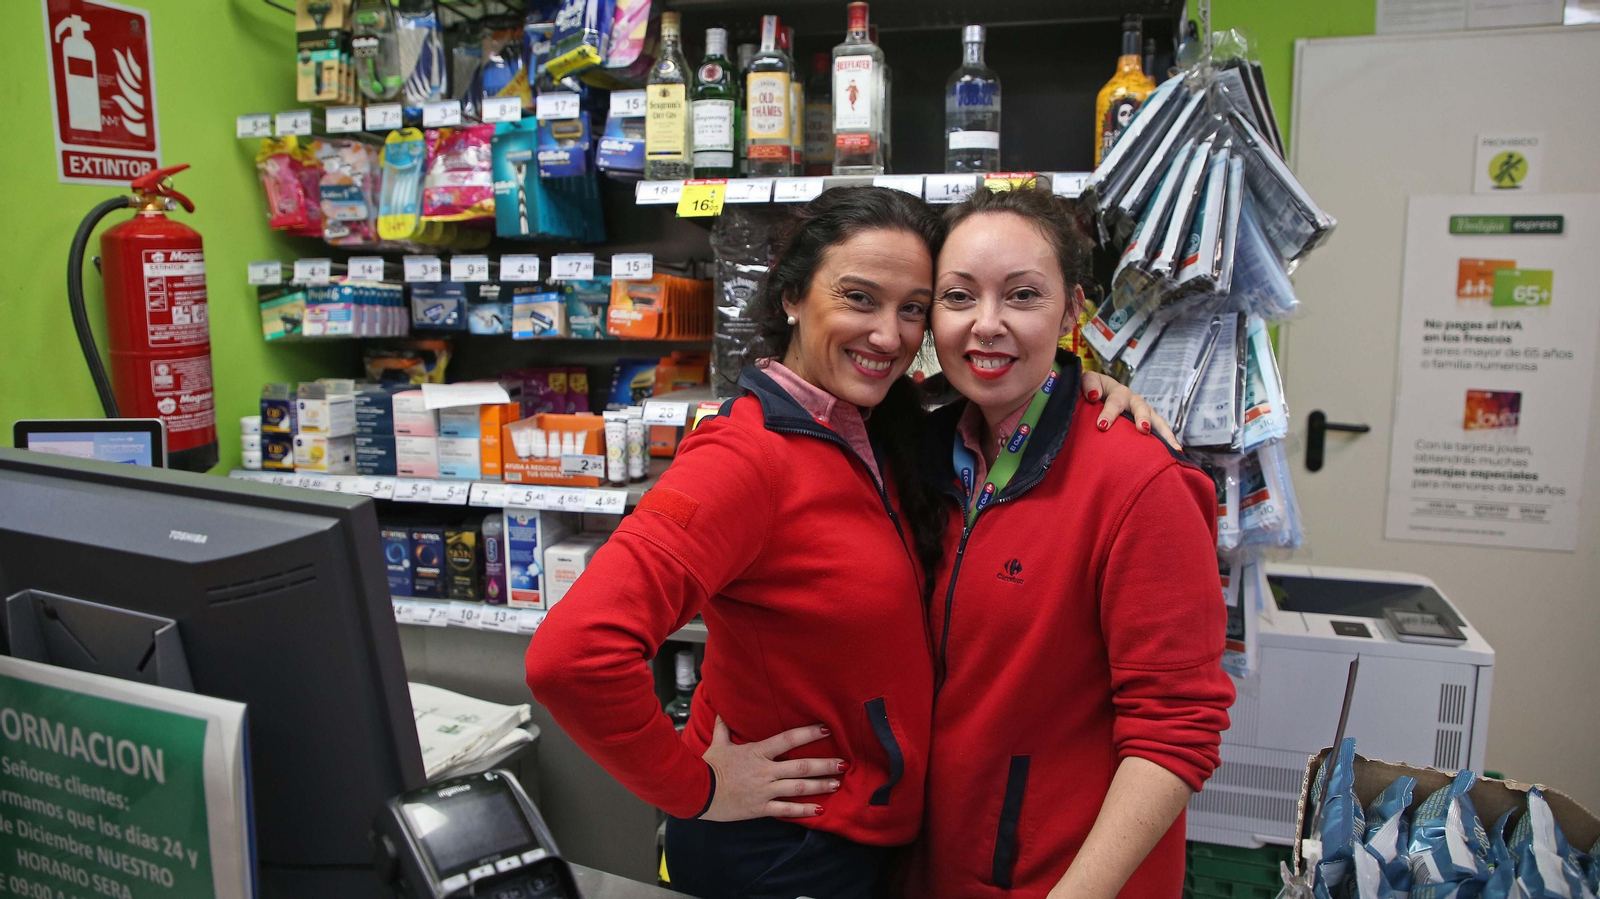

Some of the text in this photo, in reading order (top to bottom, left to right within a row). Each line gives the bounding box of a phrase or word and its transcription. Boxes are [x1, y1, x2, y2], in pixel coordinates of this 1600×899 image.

[759, 93, 774, 104] OLD
[752, 106, 782, 118] THAMES
[600, 140, 634, 151] Gillette
[1482, 137, 1538, 148] PROHIBIDO
[538, 151, 570, 160] Gillette
[69, 155, 152, 178] EXTINTOR
[1513, 219, 1558, 231] express
[1513, 286, 1550, 304] 65+
[610, 309, 644, 321] Gillette
[1424, 320, 1442, 330] No
[1486, 320, 1498, 330] el
[1500, 320, 1522, 330] IVA
[1443, 334, 1460, 343] los
[1463, 334, 1512, 344] frescos
[1435, 348, 1460, 356] eres
[1463, 348, 1502, 358] mayor
[1505, 348, 1520, 358] de
[1523, 348, 1540, 358] 65
[1542, 348, 1573, 358] años
[1432, 360, 1472, 370] familia
[1475, 362, 1538, 372] numerosa
[1259, 418, 1275, 430] x10
[1014, 434, 1024, 446] Club
[1415, 438, 1440, 450] Con
[1444, 440, 1454, 450] la
[1456, 441, 1495, 454] tarjeta
[1414, 452, 1528, 467] obtendrás muchas
[1414, 467, 1538, 481] ventajas especiales
[1411, 480, 1566, 496] para menores de 30 años
[1260, 504, 1274, 516] x10
[169, 530, 208, 544] TOSHIBA
[382, 530, 407, 539] CONTROL
[412, 532, 440, 541] CONTROL
[1, 708, 165, 784] ORMACION
[2, 756, 130, 812] Señores clientes:
[437, 784, 471, 798] ingenico
[68, 808, 96, 830] que
[99, 816, 122, 840] los
[125, 824, 158, 852] días
[162, 836, 184, 860] 24
[186, 848, 198, 870] y
[16, 819, 93, 861] Diciembre
[98, 846, 174, 888] NUESTRO
[16, 848, 132, 899] HORARIO SERA
[9, 876, 52, 899] 09:00
